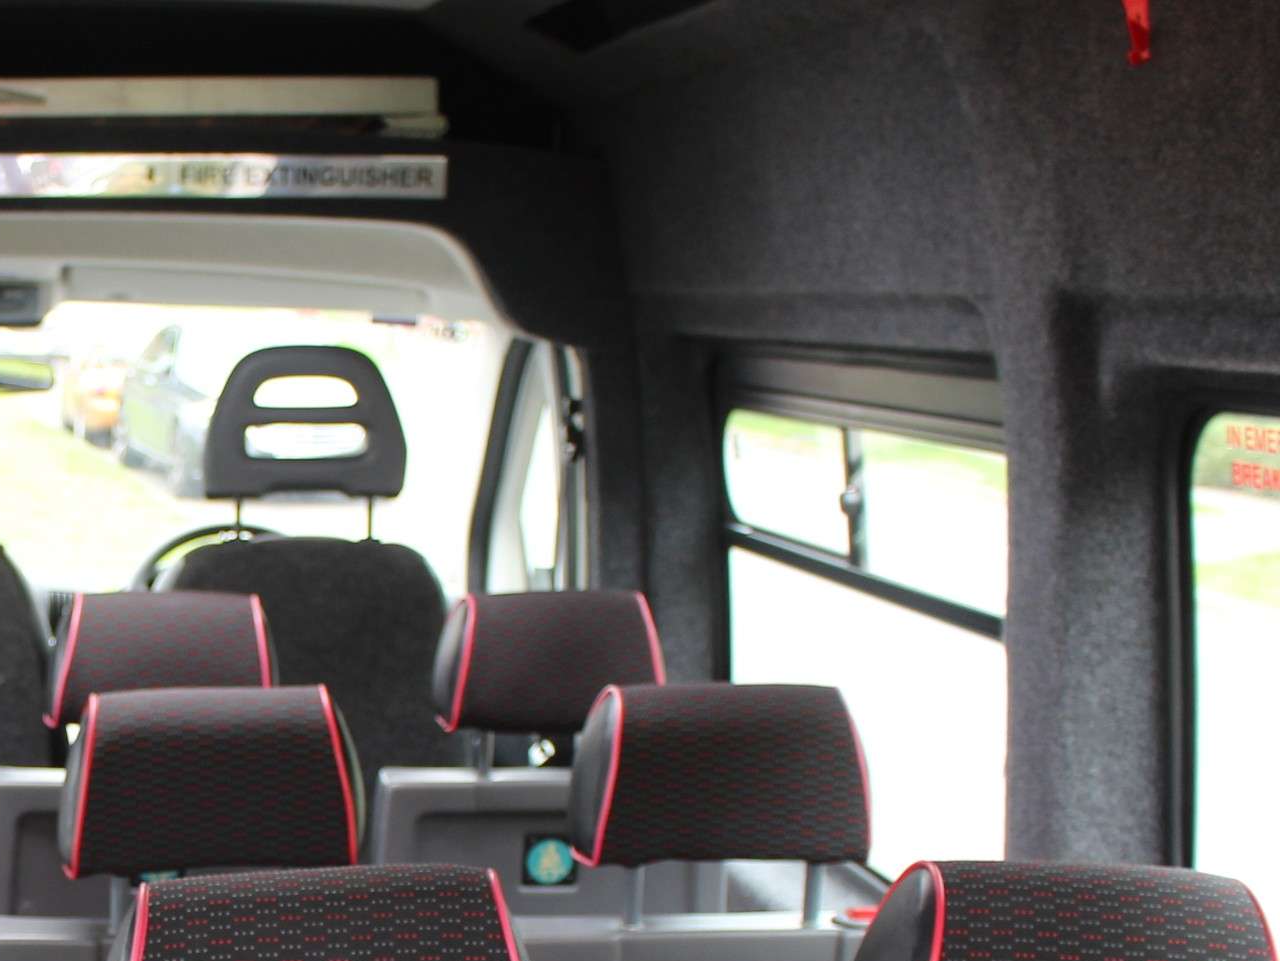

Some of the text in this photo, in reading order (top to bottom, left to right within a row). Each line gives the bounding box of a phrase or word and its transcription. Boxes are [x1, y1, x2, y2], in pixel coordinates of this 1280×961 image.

[245, 165, 433, 188] EXTINGUISHER
[1226, 424, 1280, 454] IN EME
